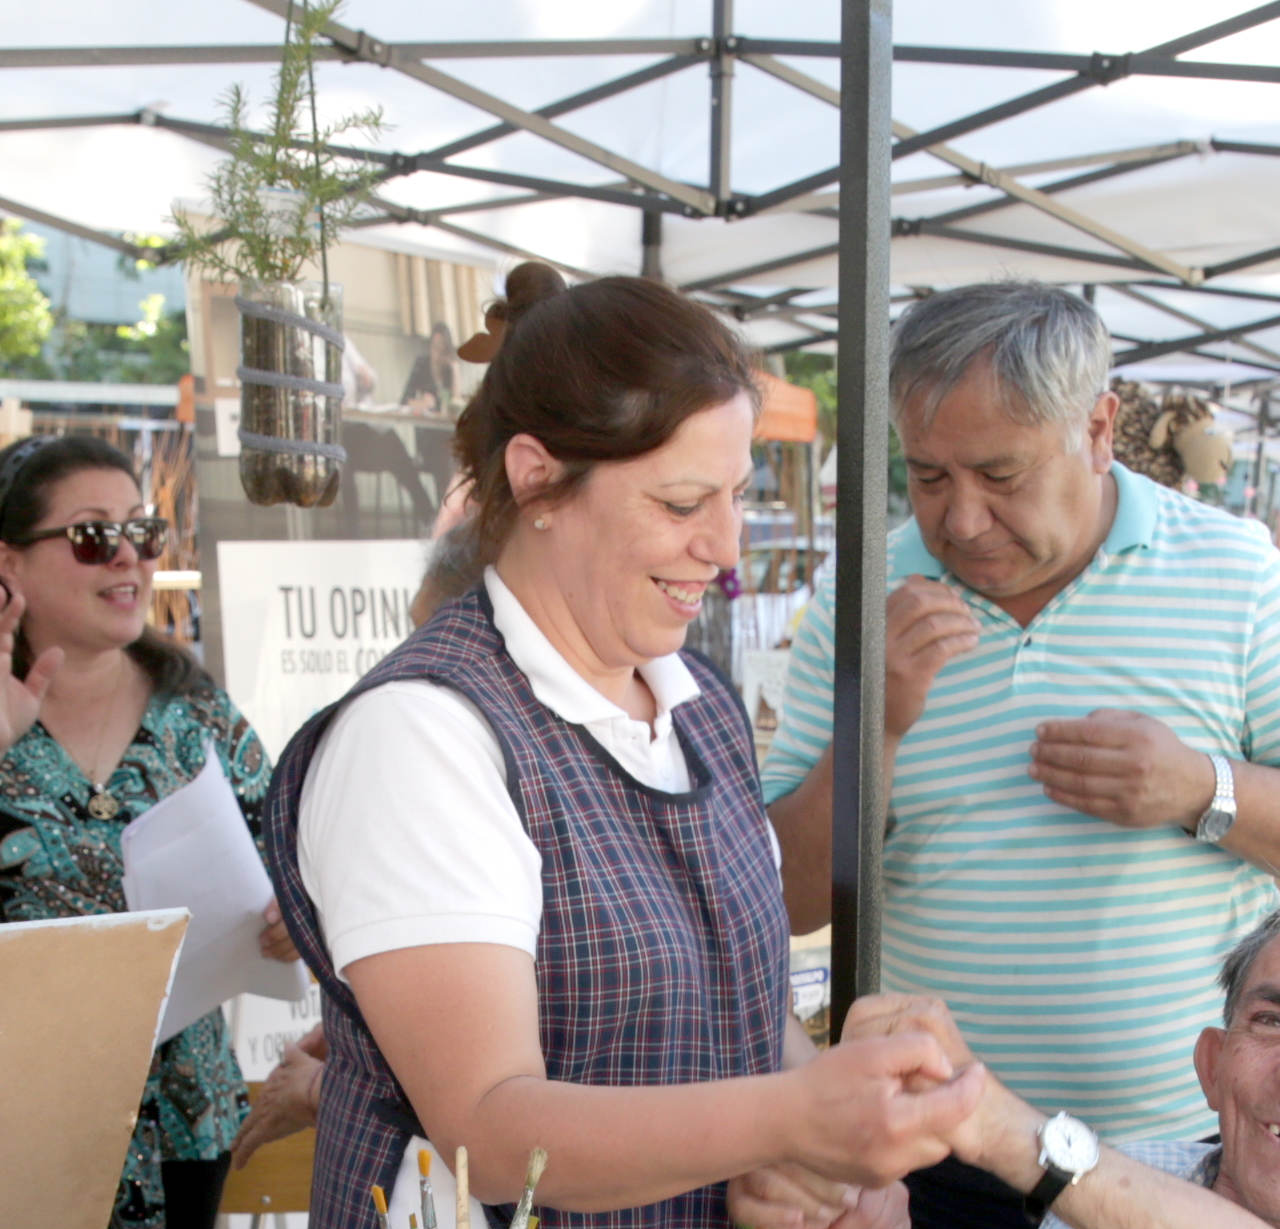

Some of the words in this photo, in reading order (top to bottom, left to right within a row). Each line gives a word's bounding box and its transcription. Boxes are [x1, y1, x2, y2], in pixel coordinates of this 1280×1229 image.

[278, 585, 317, 640] TU
[280, 648, 298, 675] ES
[299, 648, 333, 676] SOLO
[336, 648, 350, 675] EL
[354, 647, 384, 678] CO
